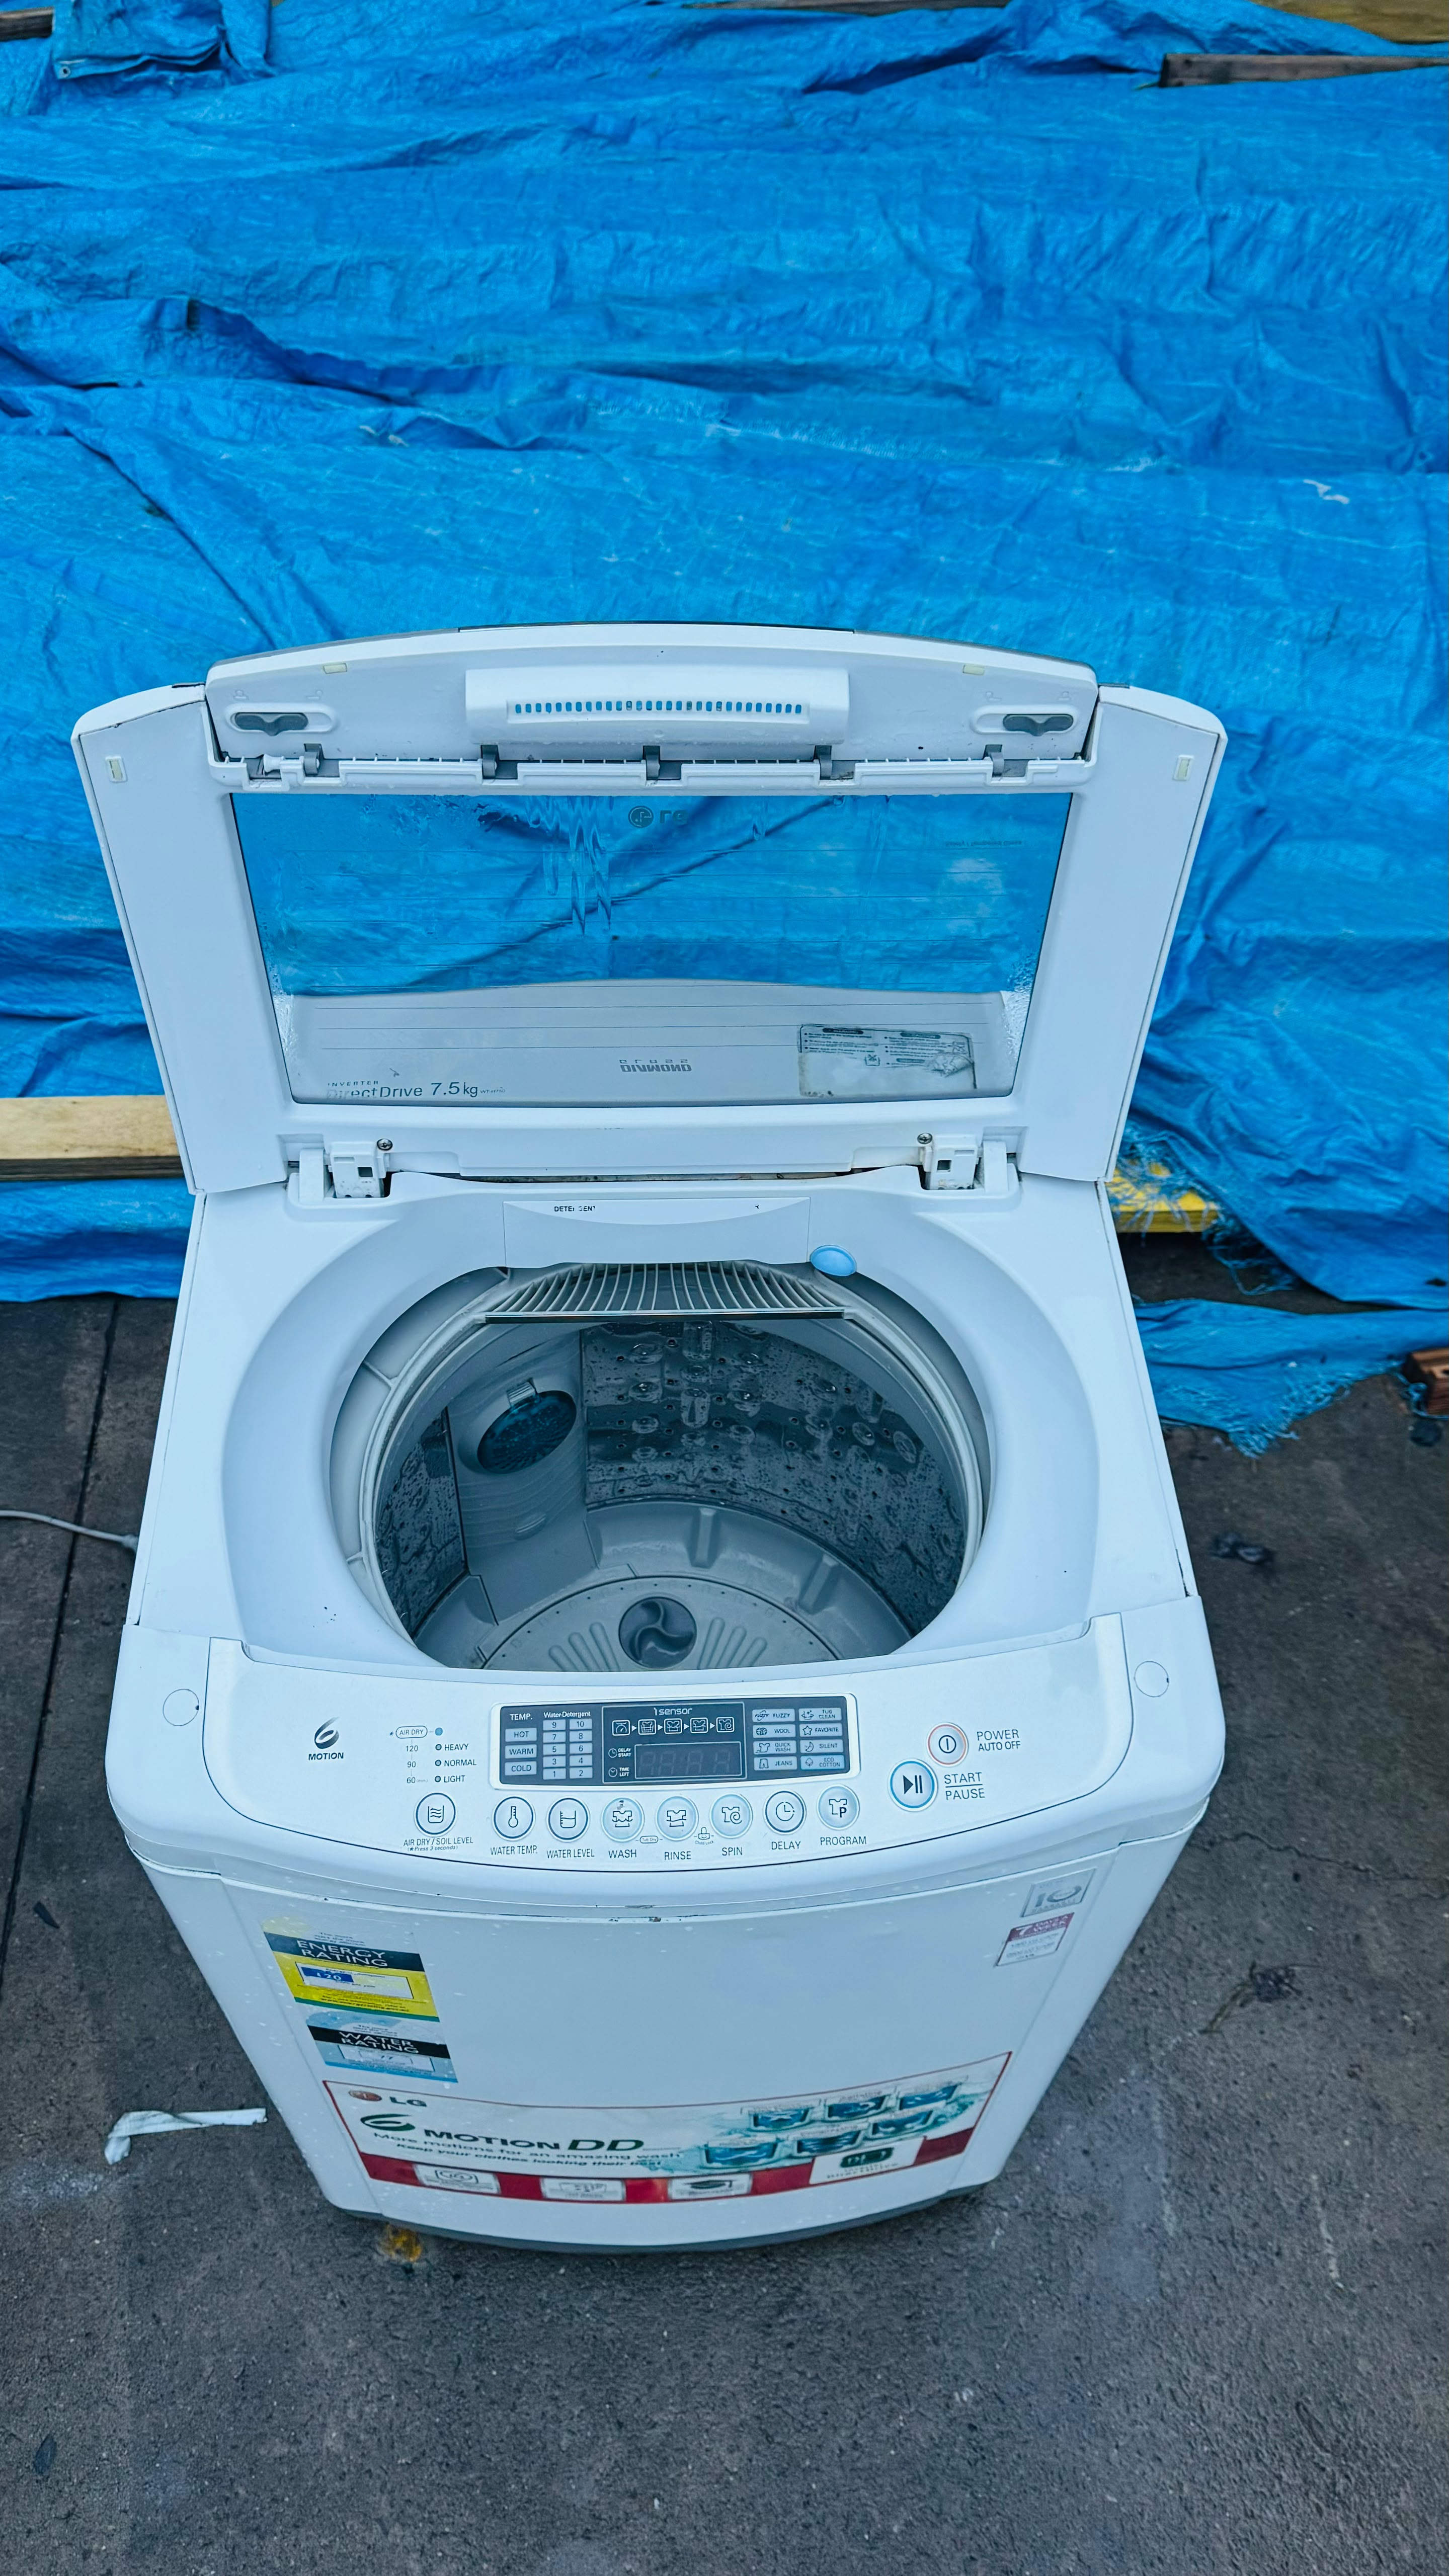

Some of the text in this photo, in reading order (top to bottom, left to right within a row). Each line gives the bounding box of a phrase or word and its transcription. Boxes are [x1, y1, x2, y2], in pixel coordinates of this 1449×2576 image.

[977, 1729, 1019, 1741] POWER
[978, 1741, 1021, 1751] AUTO OFF
[308, 1752, 344, 1760] MOTION
[444, 1759, 476, 1767] NORMAL
[944, 1773, 982, 1784] START
[946, 1788, 985, 1800] PAUSE
[771, 1841, 801, 1850] DELAY
[820, 1836, 866, 1845] PROGRAM
[491, 1845, 537, 1855] WATER TEMP.
[547, 1848, 595, 1859] WATER LEVEL
[608, 1849, 637, 1858] WASH
[722, 1847, 743, 1856] SPIN
[664, 1852, 691, 1860] RINSE
[297, 1940, 385, 1959] ENERGY
[301, 1949, 388, 1967] RATING
[339, 2032, 414, 2047] WATER
[341, 2038, 419, 2053] RATING
[389, 2097, 427, 2107] LG
[374, 2133, 417, 2143] More
[424, 2141, 494, 2153] motions
[424, 2129, 560, 2150] MOTION
[568, 2139, 644, 2151] DD
[396, 2143, 433, 2152] Keep
